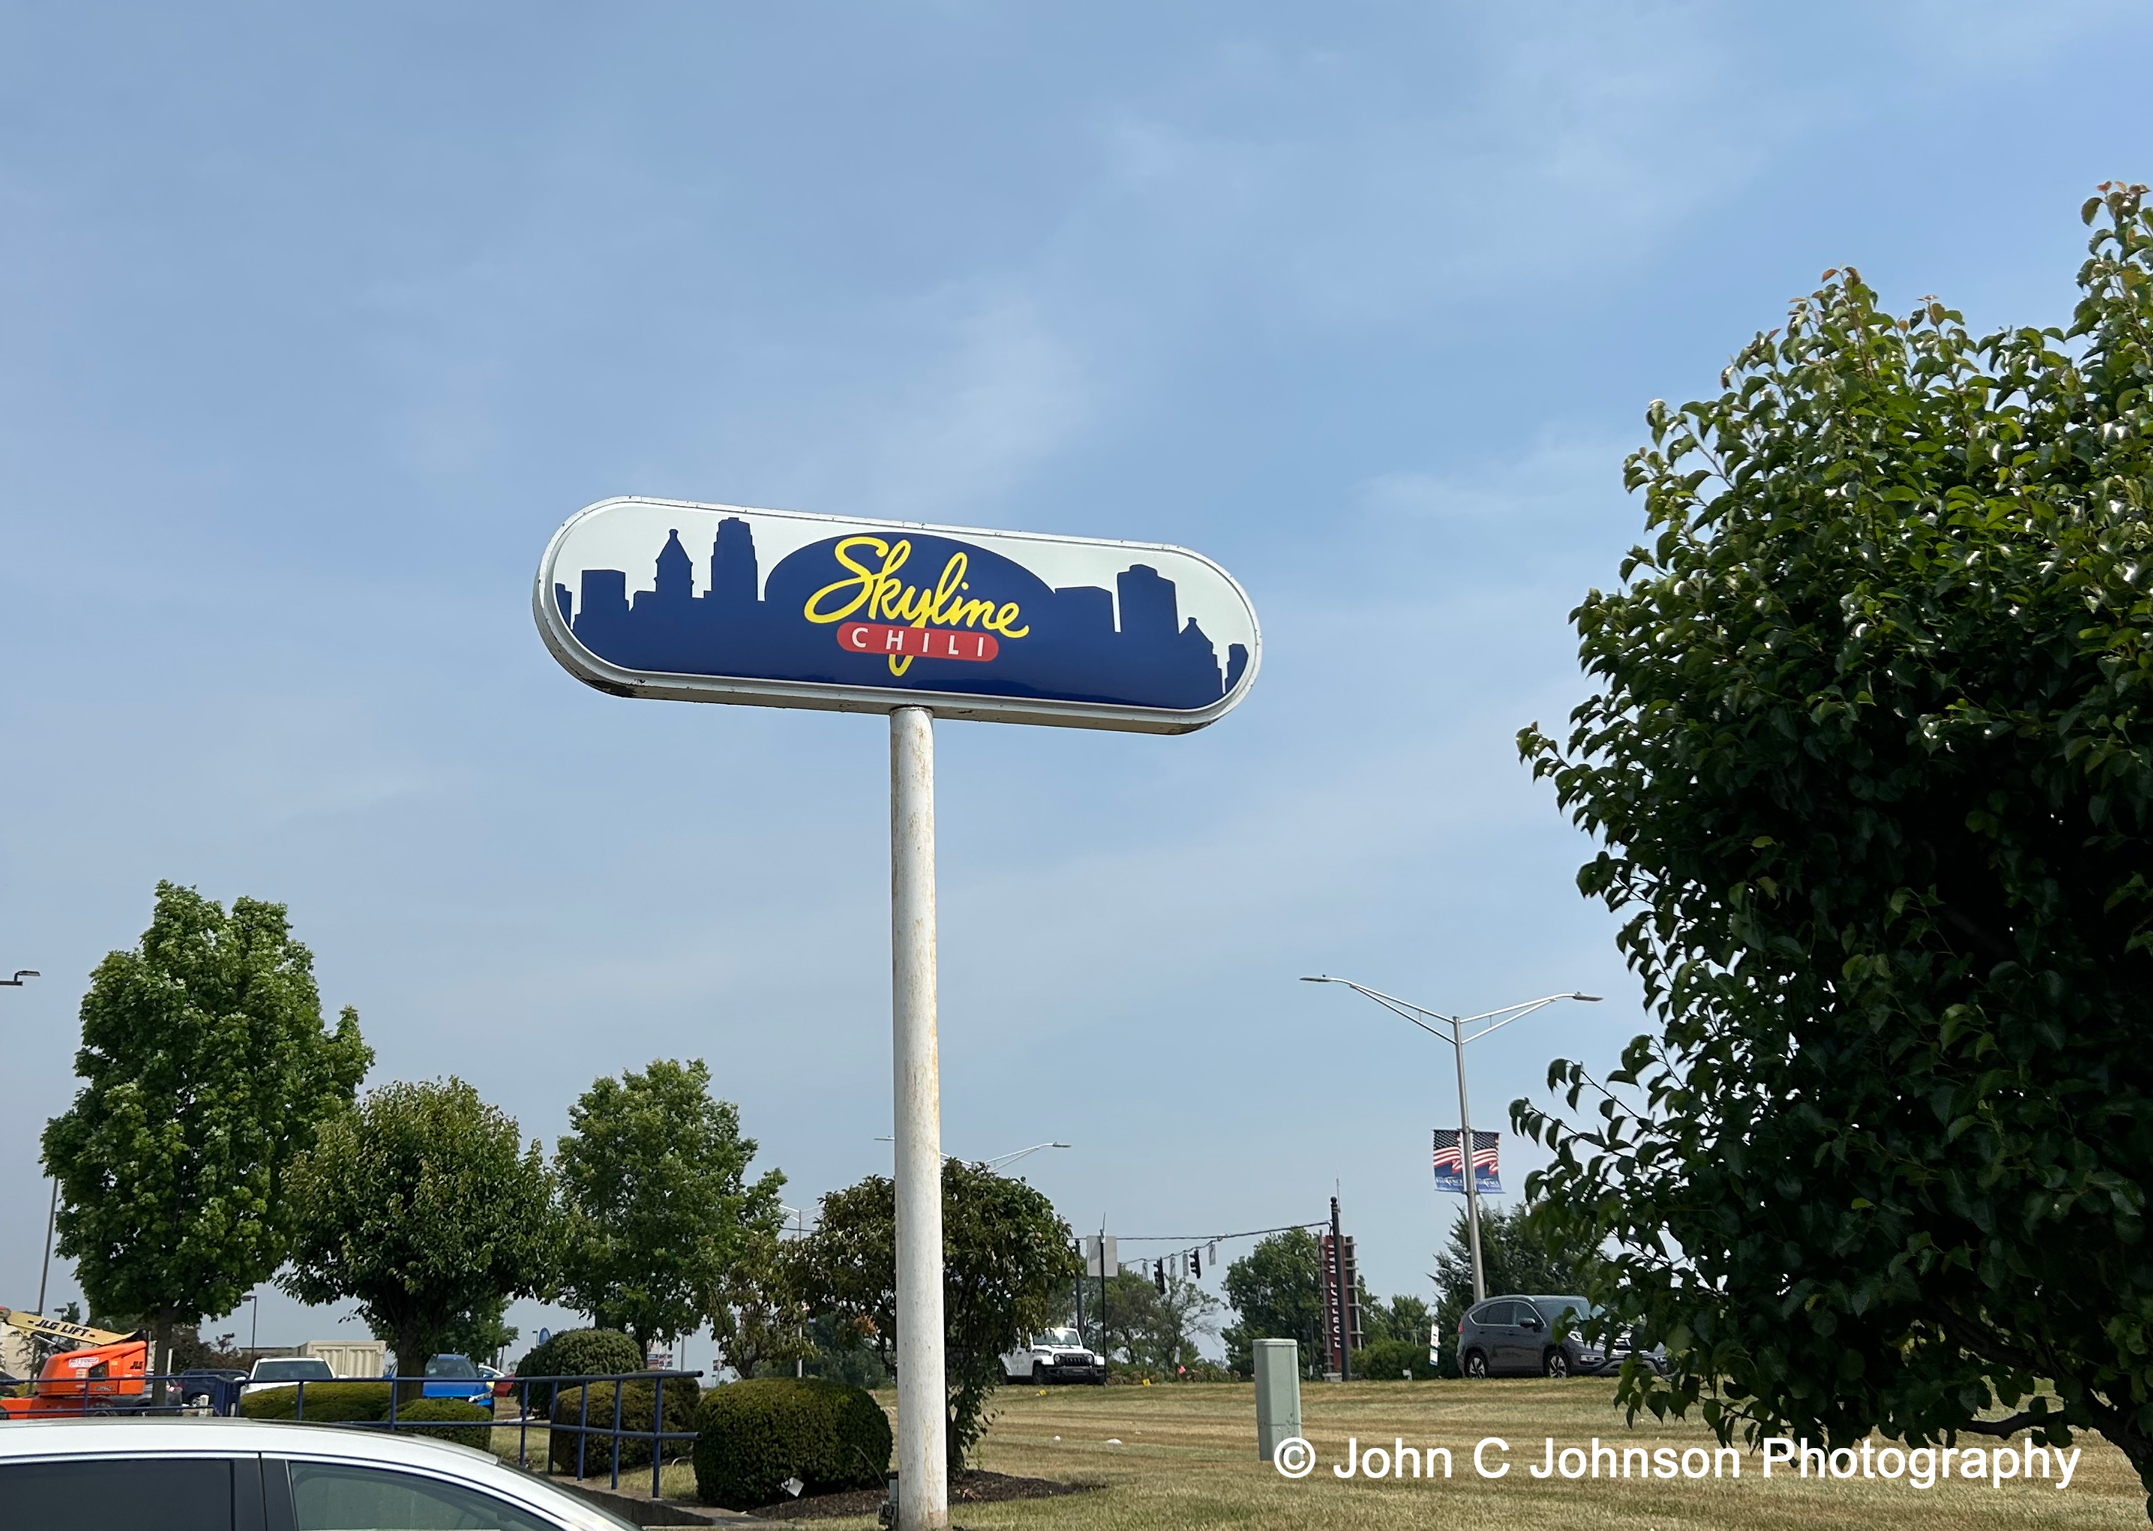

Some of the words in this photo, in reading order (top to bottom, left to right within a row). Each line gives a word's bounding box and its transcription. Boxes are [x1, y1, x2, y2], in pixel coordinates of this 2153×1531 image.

[803, 536, 1030, 677] Skyline
[851, 627, 985, 657] CHILI
[35, 1319, 60, 1331] JLG
[60, 1324, 91, 1337] LIFT
